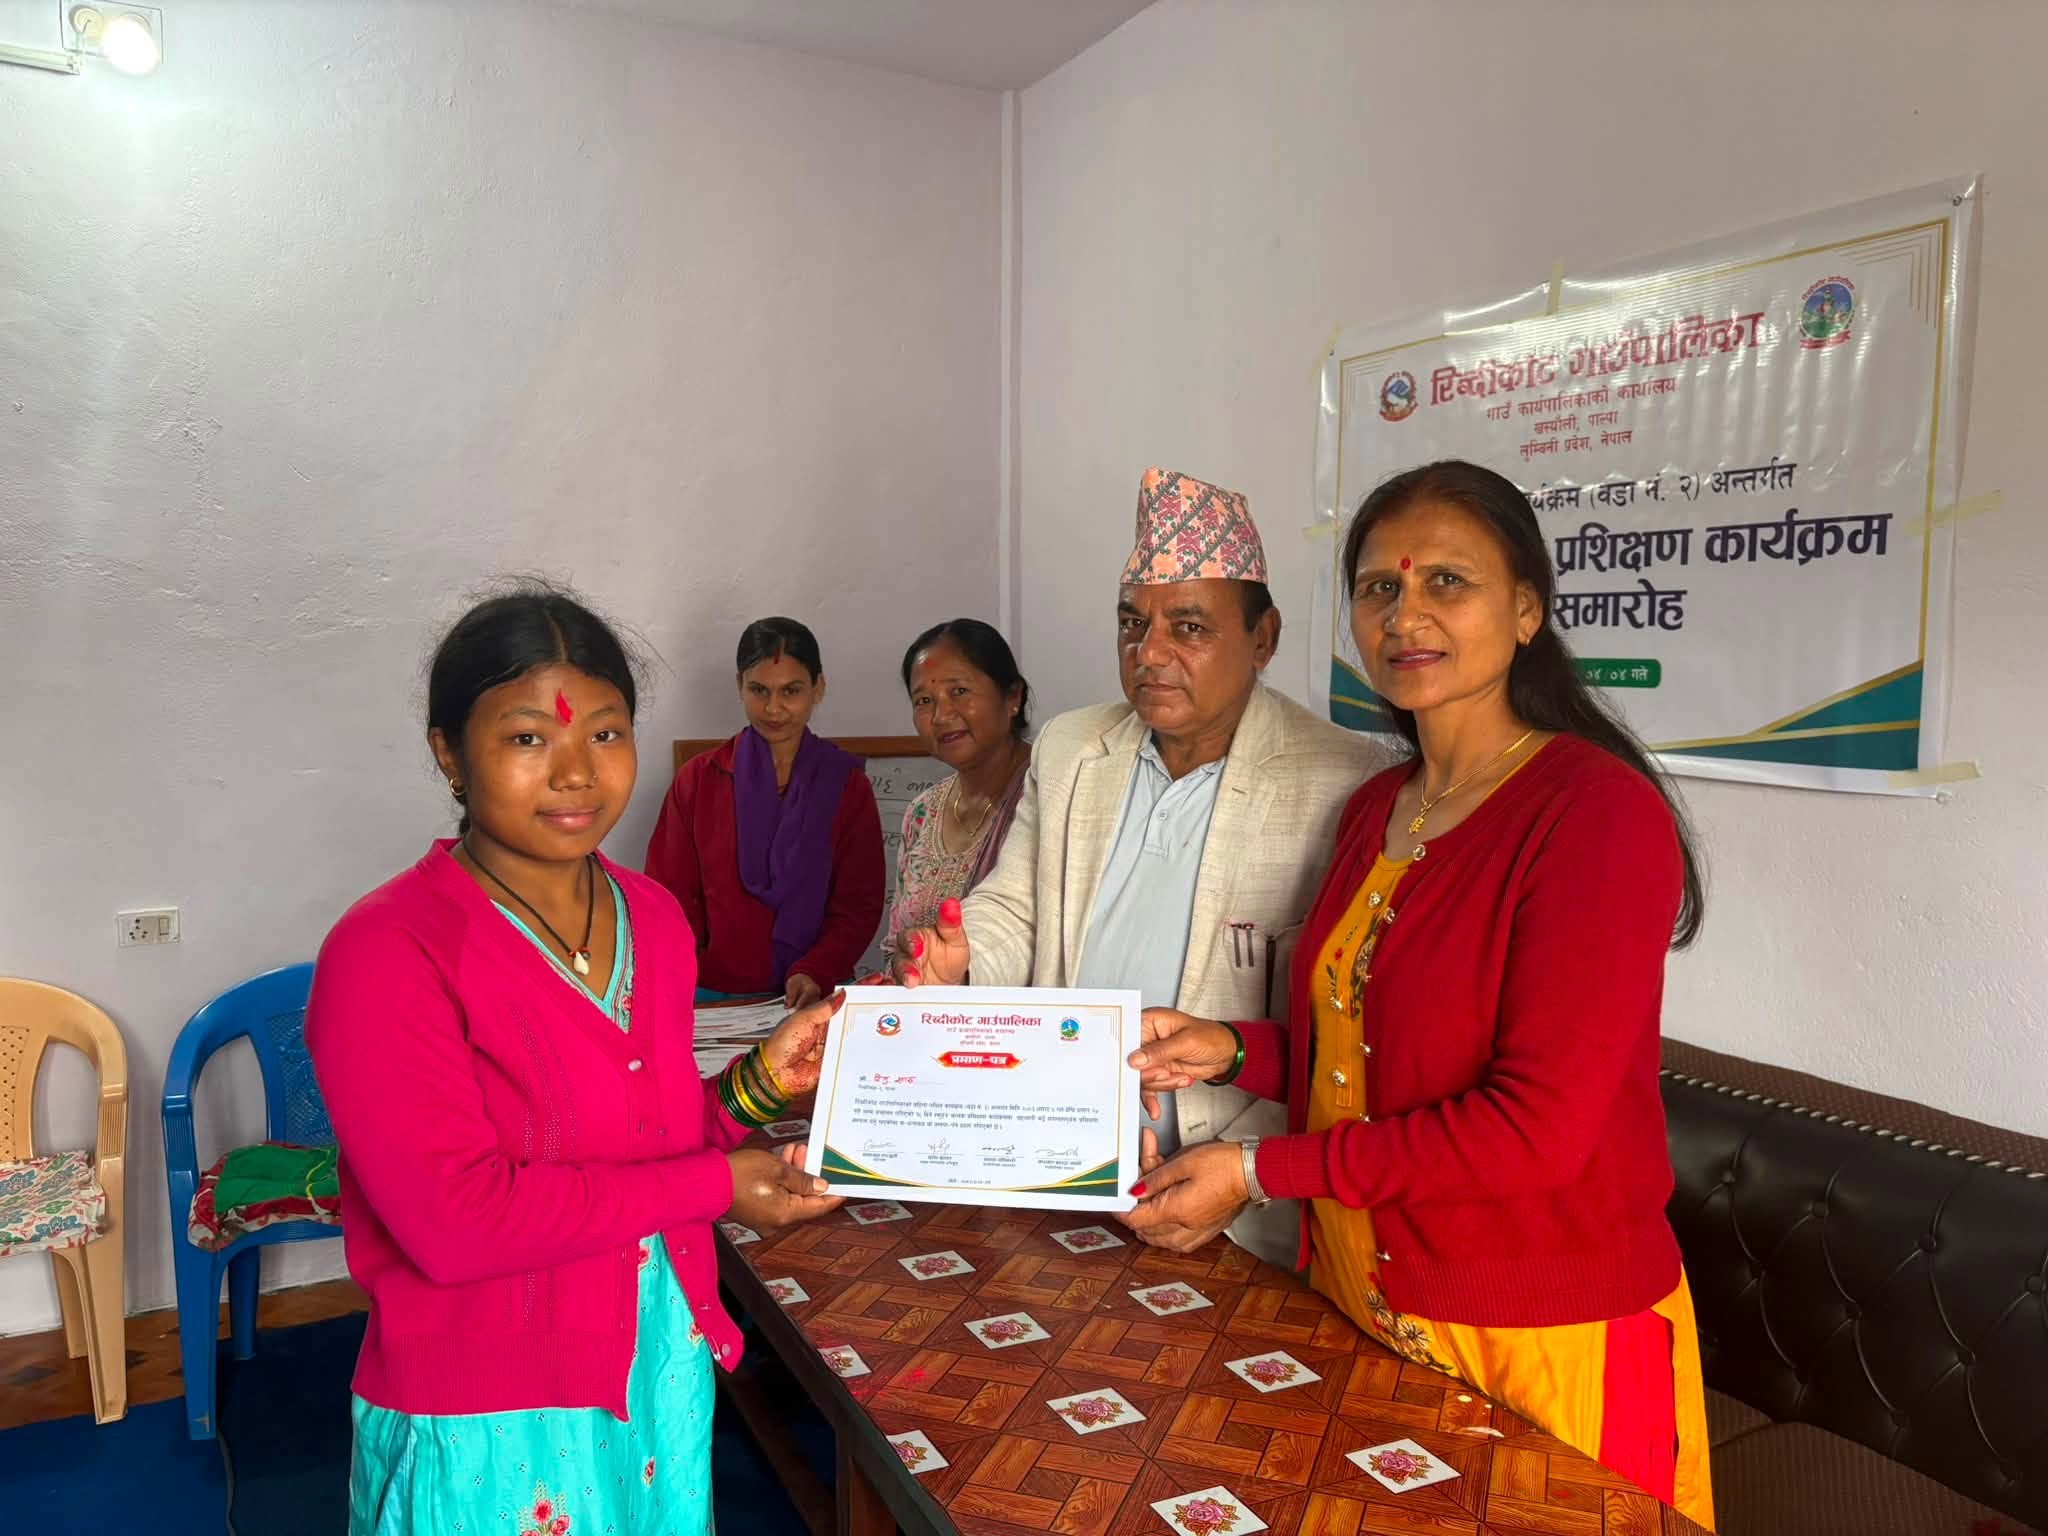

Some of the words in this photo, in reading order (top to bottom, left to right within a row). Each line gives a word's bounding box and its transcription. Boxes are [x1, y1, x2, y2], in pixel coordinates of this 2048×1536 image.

[1600, 430, 1633, 446] नेपाल
[1554, 521, 1693, 576] प्रशिक्षण
[1704, 508, 1893, 566] कार्यक्रम
[1552, 578, 1688, 631] समारोह
[921, 1012, 974, 1025] रिब्दीकोट
